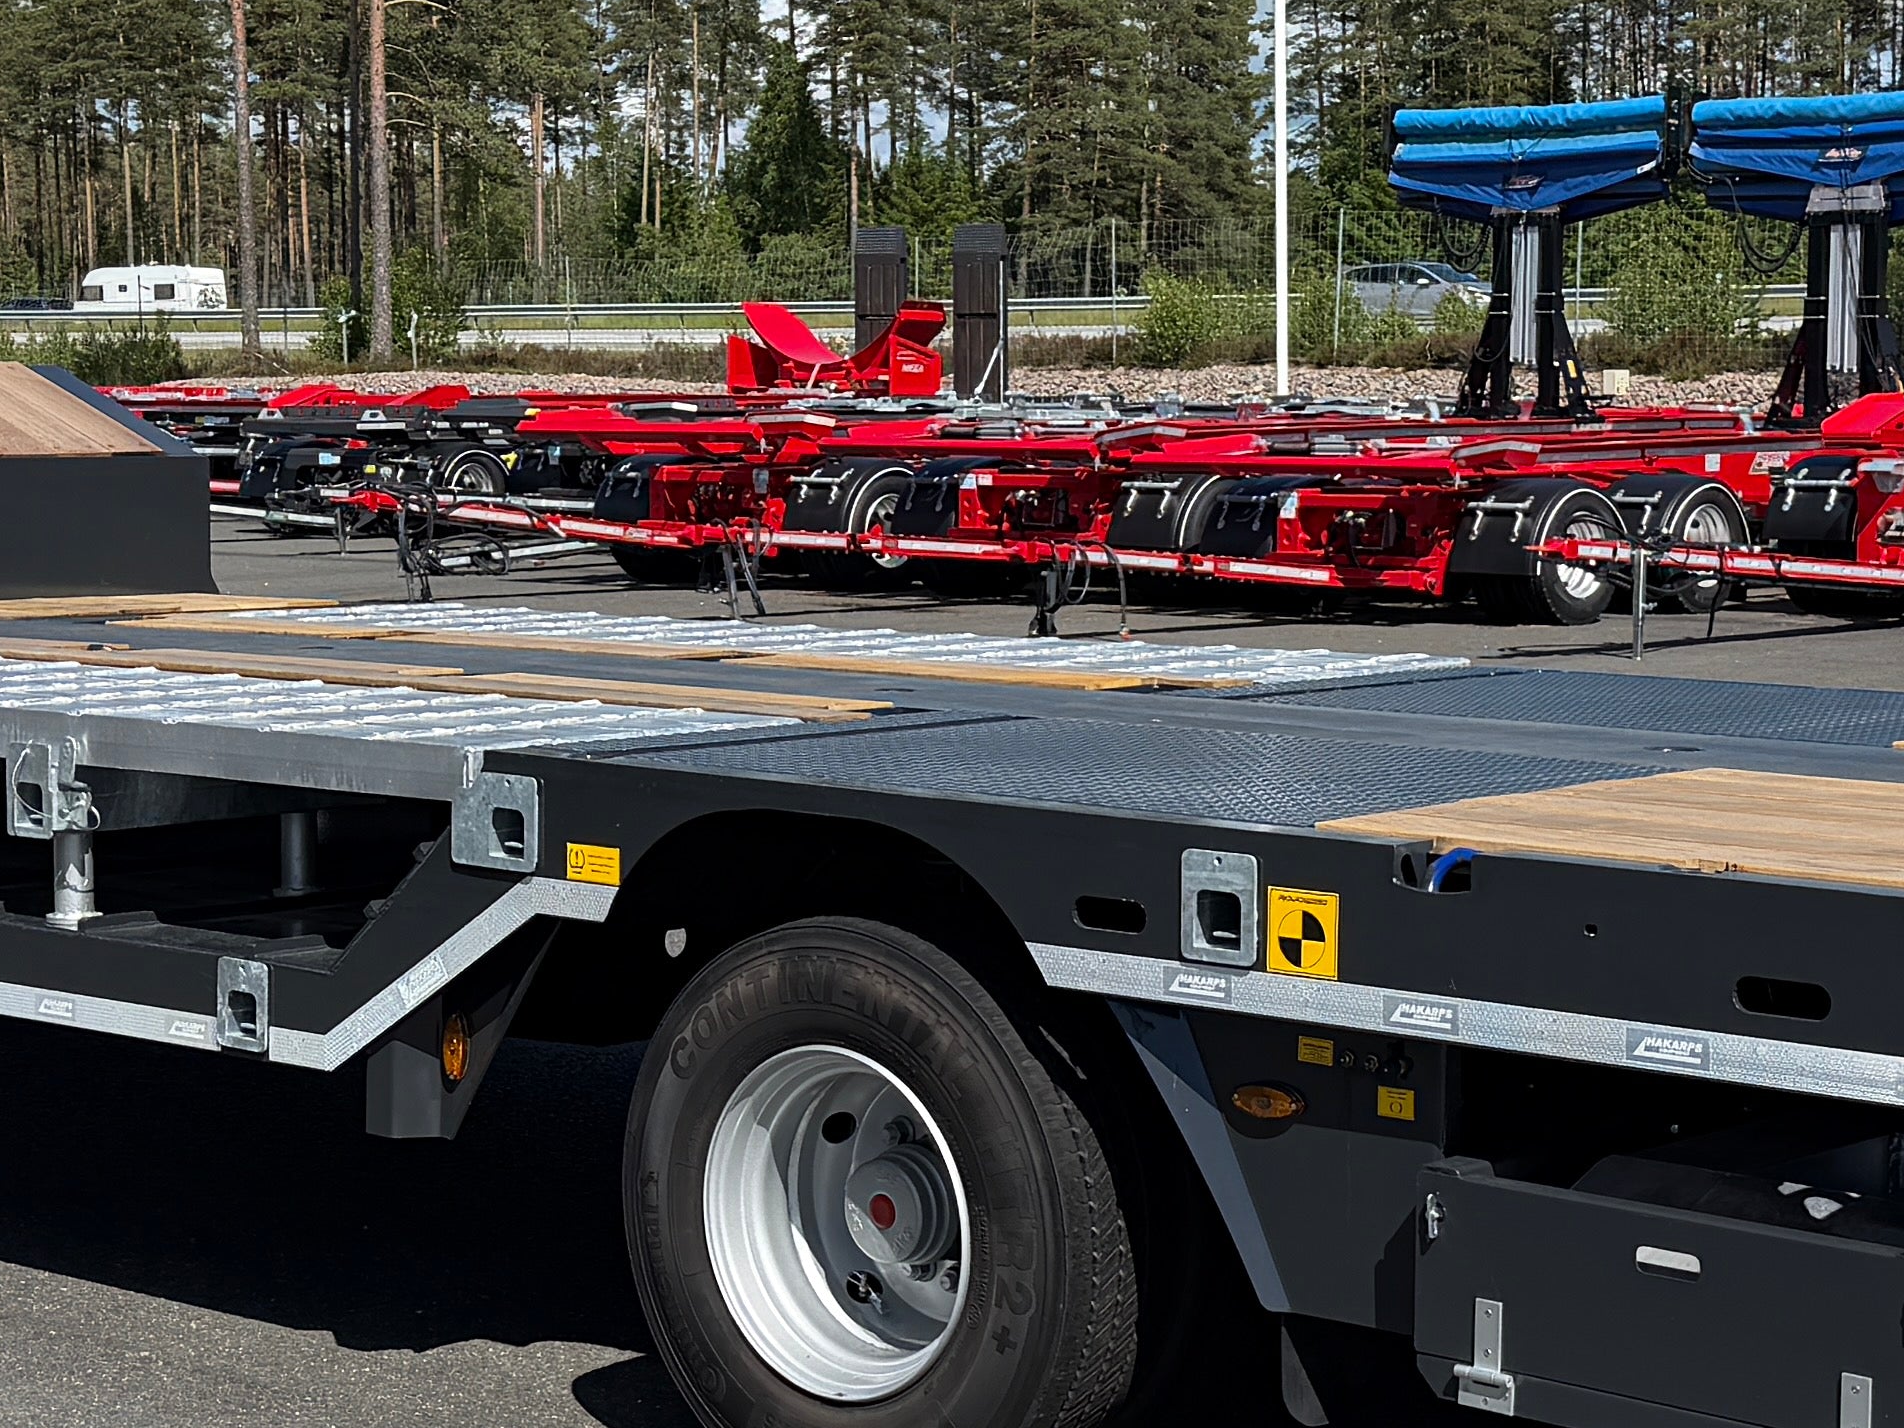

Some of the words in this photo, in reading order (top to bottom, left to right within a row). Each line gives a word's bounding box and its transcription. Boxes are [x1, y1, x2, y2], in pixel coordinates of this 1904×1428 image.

[1178, 973, 1227, 989] HAKARPS
[1400, 1002, 1453, 1020] HAKARPS
[670, 956, 982, 1100] CONTINENTAL
[1646, 1036, 1704, 1054] HAKARPS
